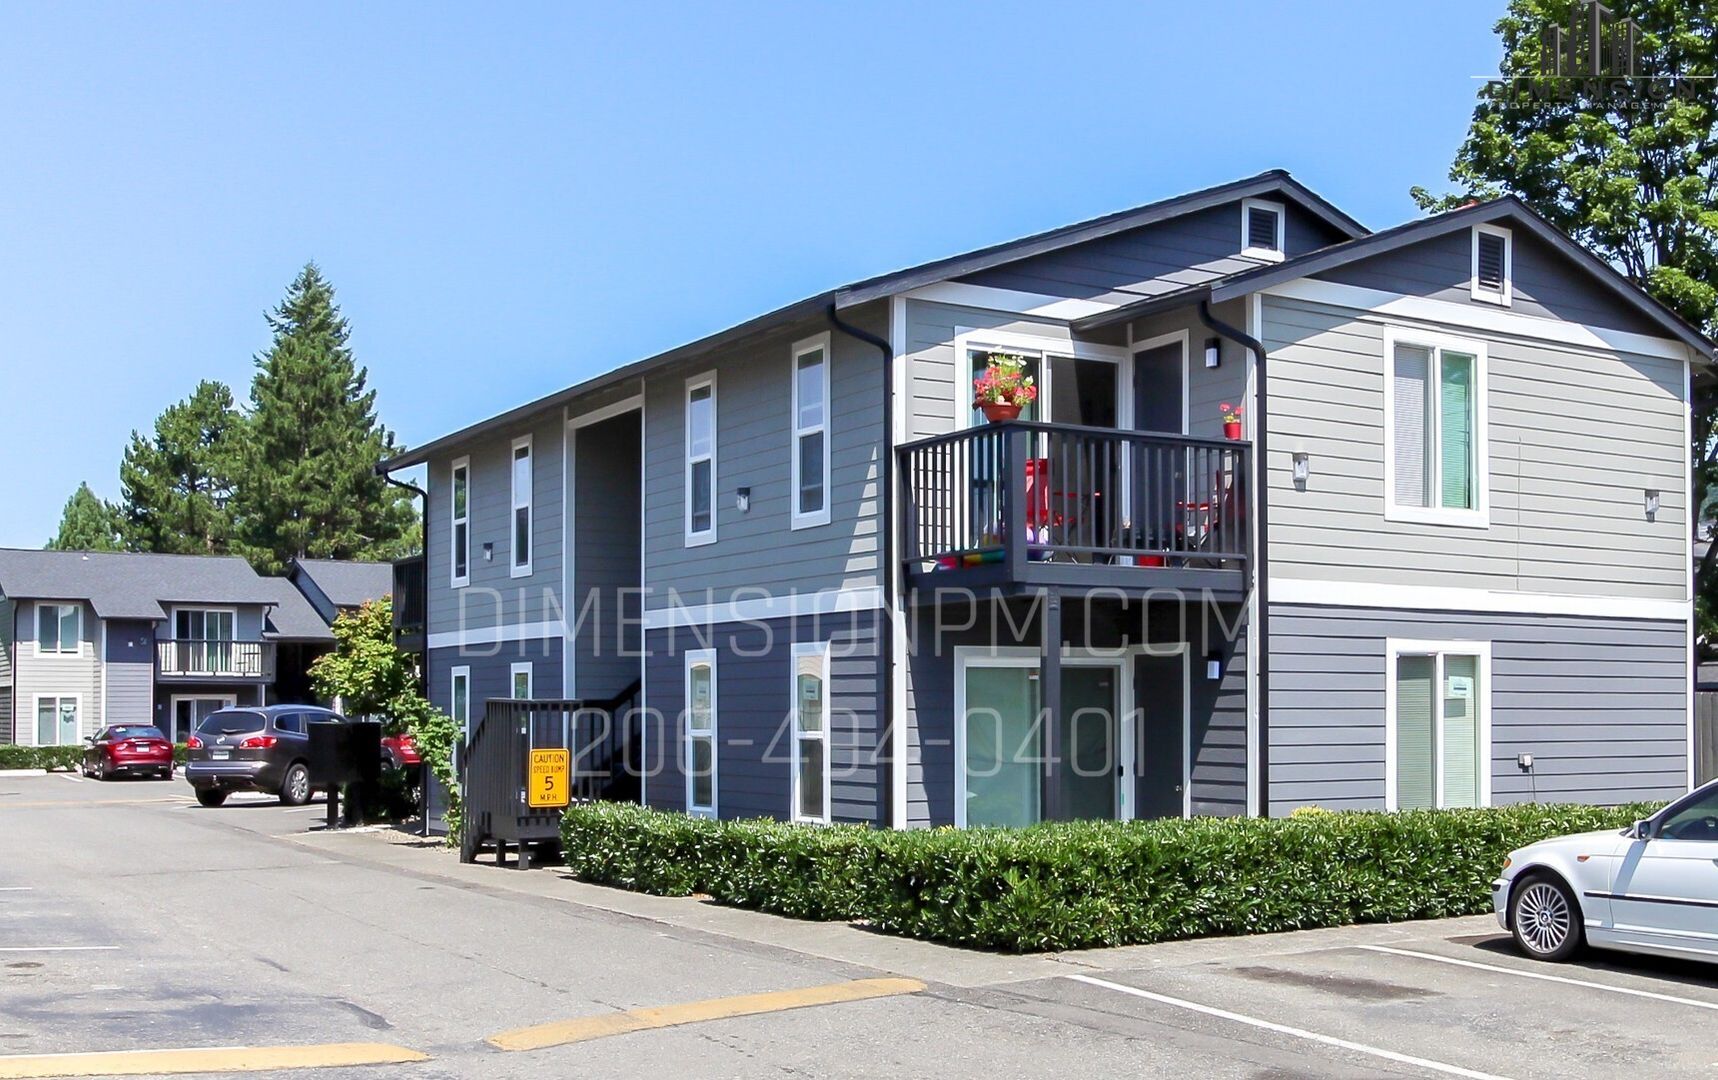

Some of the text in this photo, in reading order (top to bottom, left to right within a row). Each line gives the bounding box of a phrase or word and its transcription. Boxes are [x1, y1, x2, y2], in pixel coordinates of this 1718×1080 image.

[533, 754, 564, 763] CAUTION
[533, 765, 550, 773] SPEED
[545, 776, 554, 791] 5
